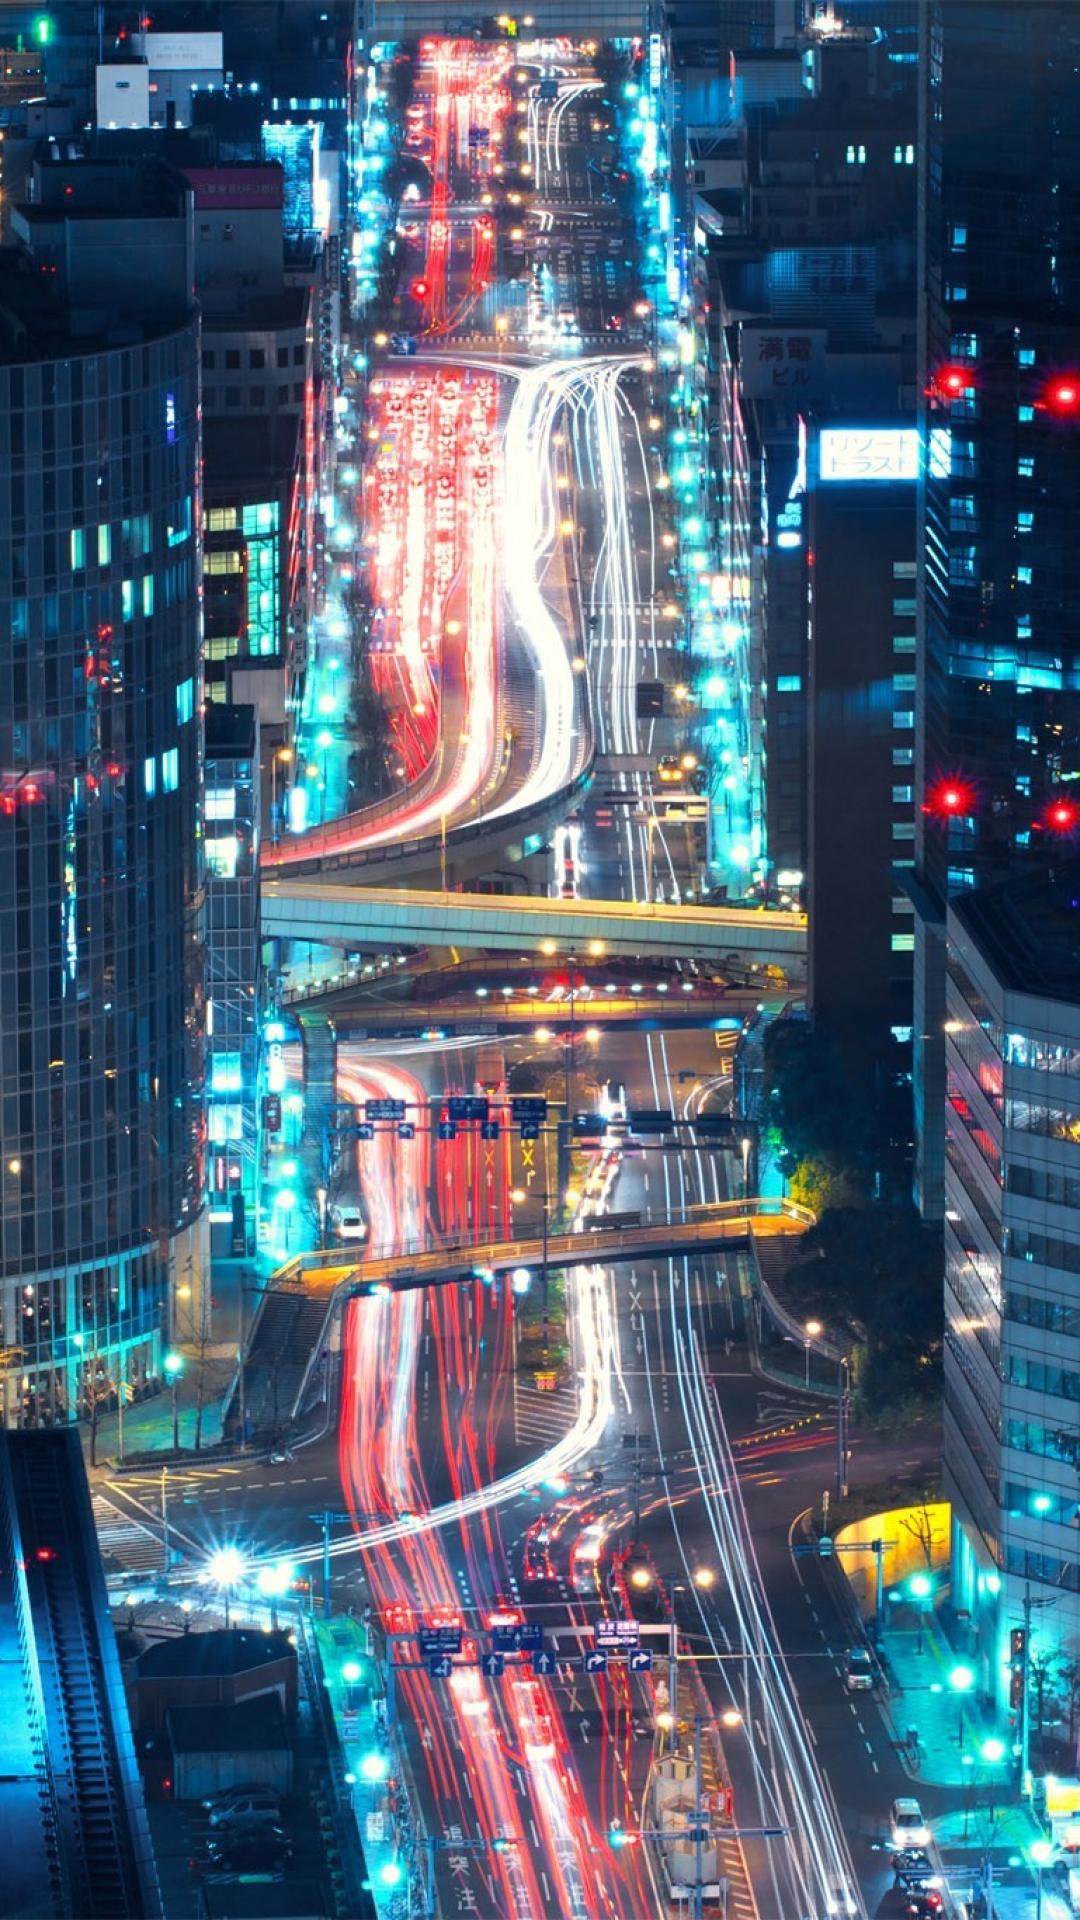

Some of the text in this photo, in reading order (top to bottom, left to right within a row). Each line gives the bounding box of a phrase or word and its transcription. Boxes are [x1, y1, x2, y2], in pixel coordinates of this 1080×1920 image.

[772, 368, 810, 386] ビル
[831, 455, 911, 473] トラスト
